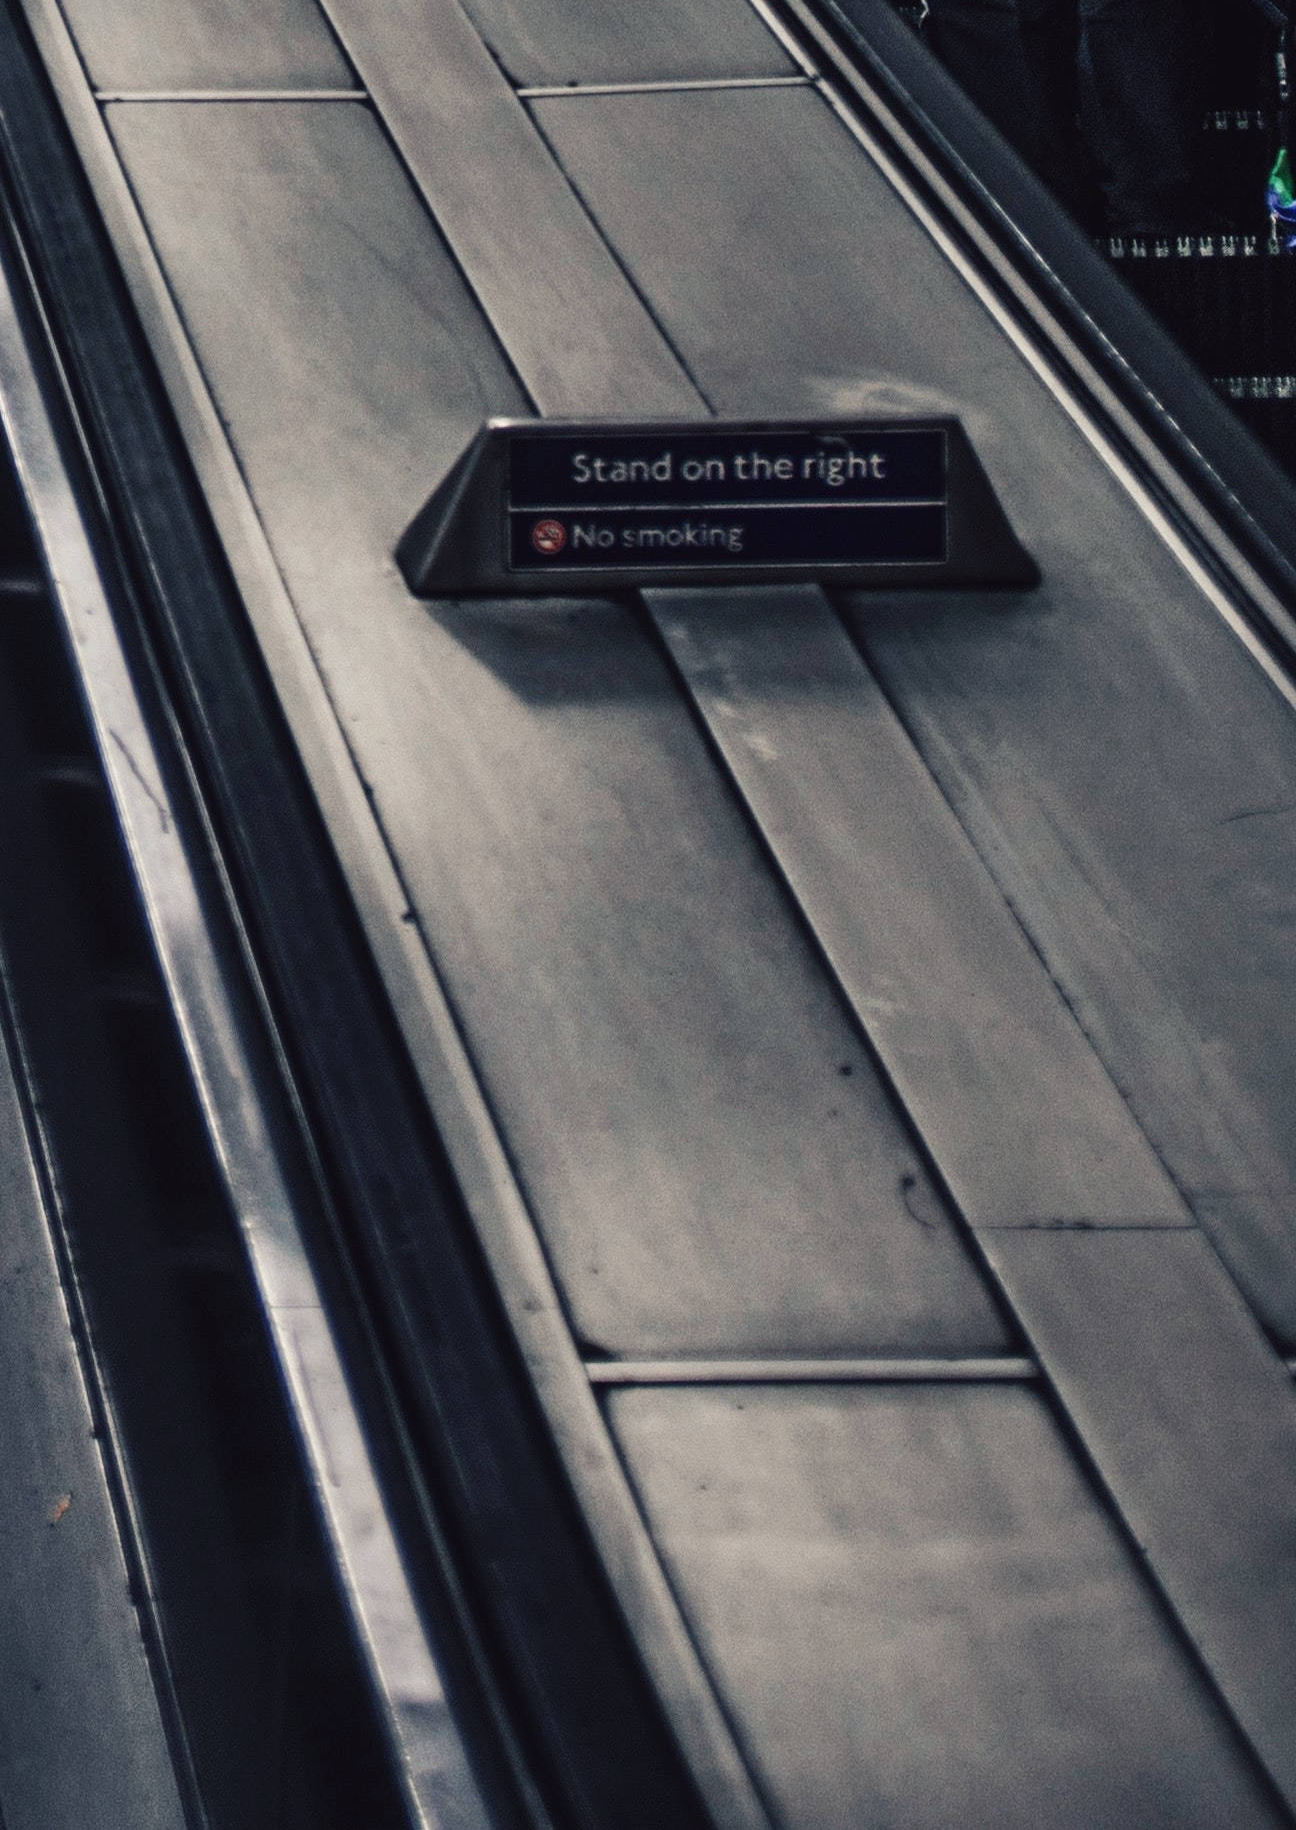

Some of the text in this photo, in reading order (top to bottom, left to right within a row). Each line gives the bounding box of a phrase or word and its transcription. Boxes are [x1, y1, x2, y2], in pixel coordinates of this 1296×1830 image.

[573, 451, 886, 487] Stand on the right
[572, 521, 746, 553] No smoking
